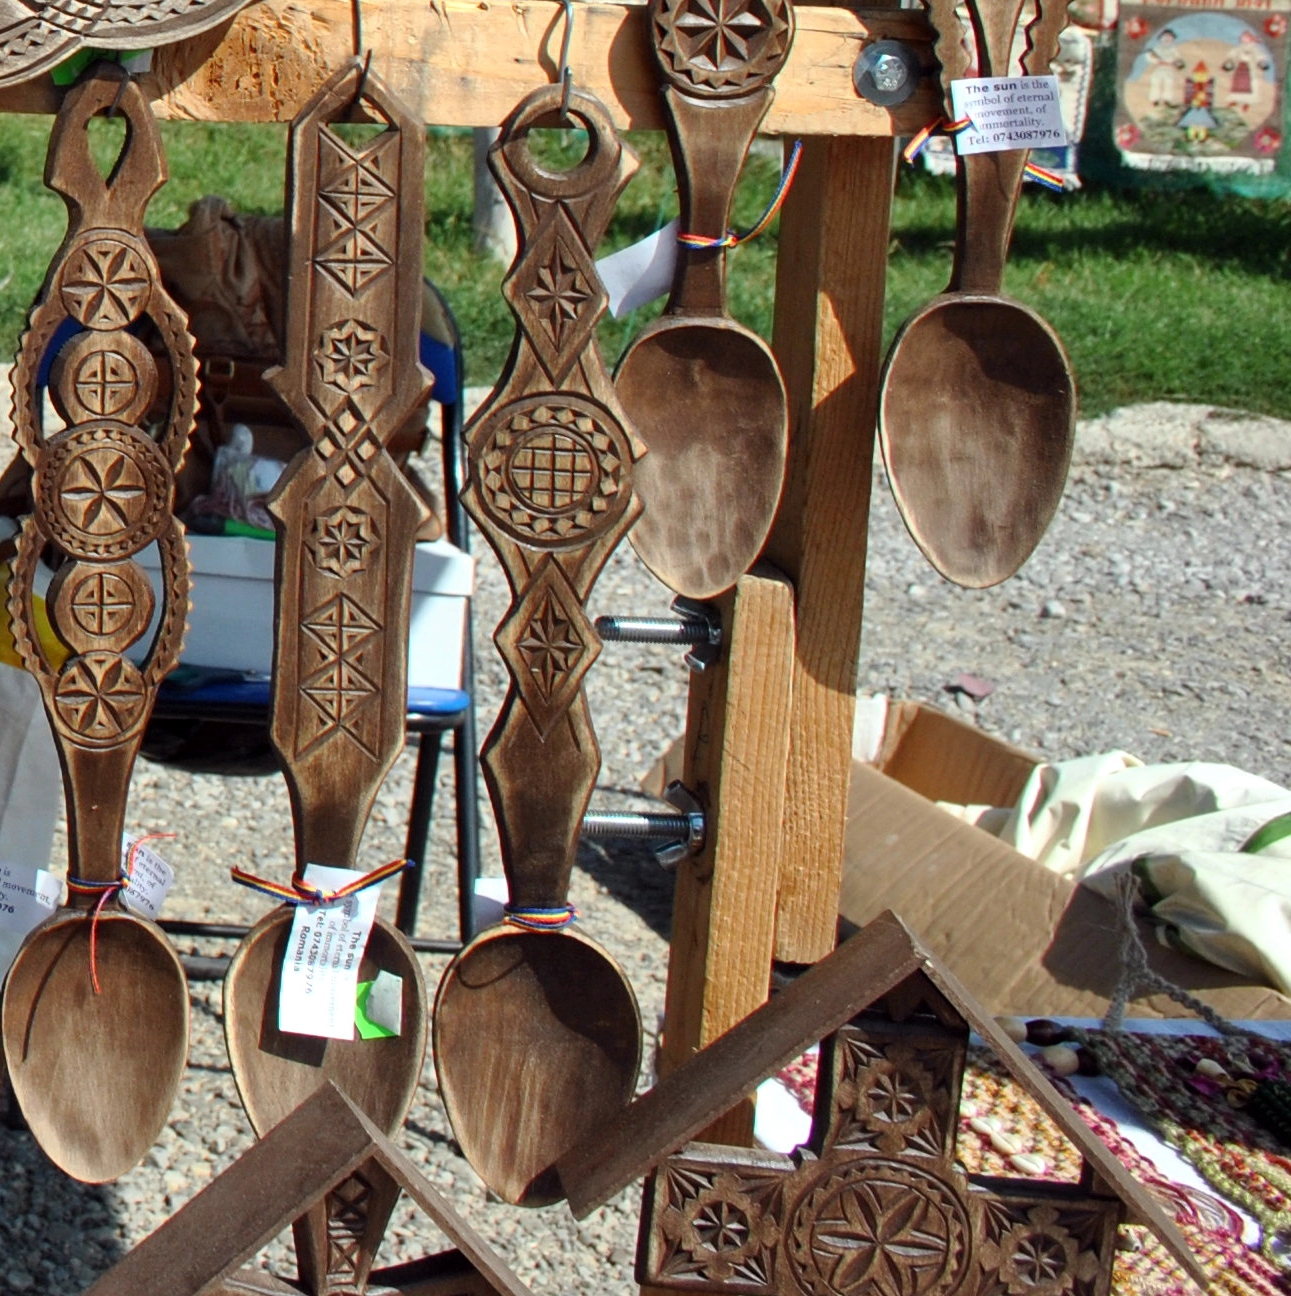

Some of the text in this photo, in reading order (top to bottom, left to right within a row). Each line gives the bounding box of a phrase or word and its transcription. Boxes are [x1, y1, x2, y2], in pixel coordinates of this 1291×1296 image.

[966, 80, 1049, 95] The sun is the
[964, 92, 1054, 109] symbol of eternal
[974, 104, 1047, 119] movement, of
[967, 129, 1060, 146] Tel: 0743087976
[3, 868, 11, 876] is
[146, 855, 153, 864] is
[154, 861, 167, 874] the
[139, 861, 166, 886] eternal
[147, 880, 156, 889] of
[328, 920, 335, 933] of
[338, 933, 346, 946] of
[350, 930, 362, 954] The
[293, 925, 311, 972] Romania
[304, 910, 327, 994] Tel: 0743087976
[343, 953, 356, 970] sun
